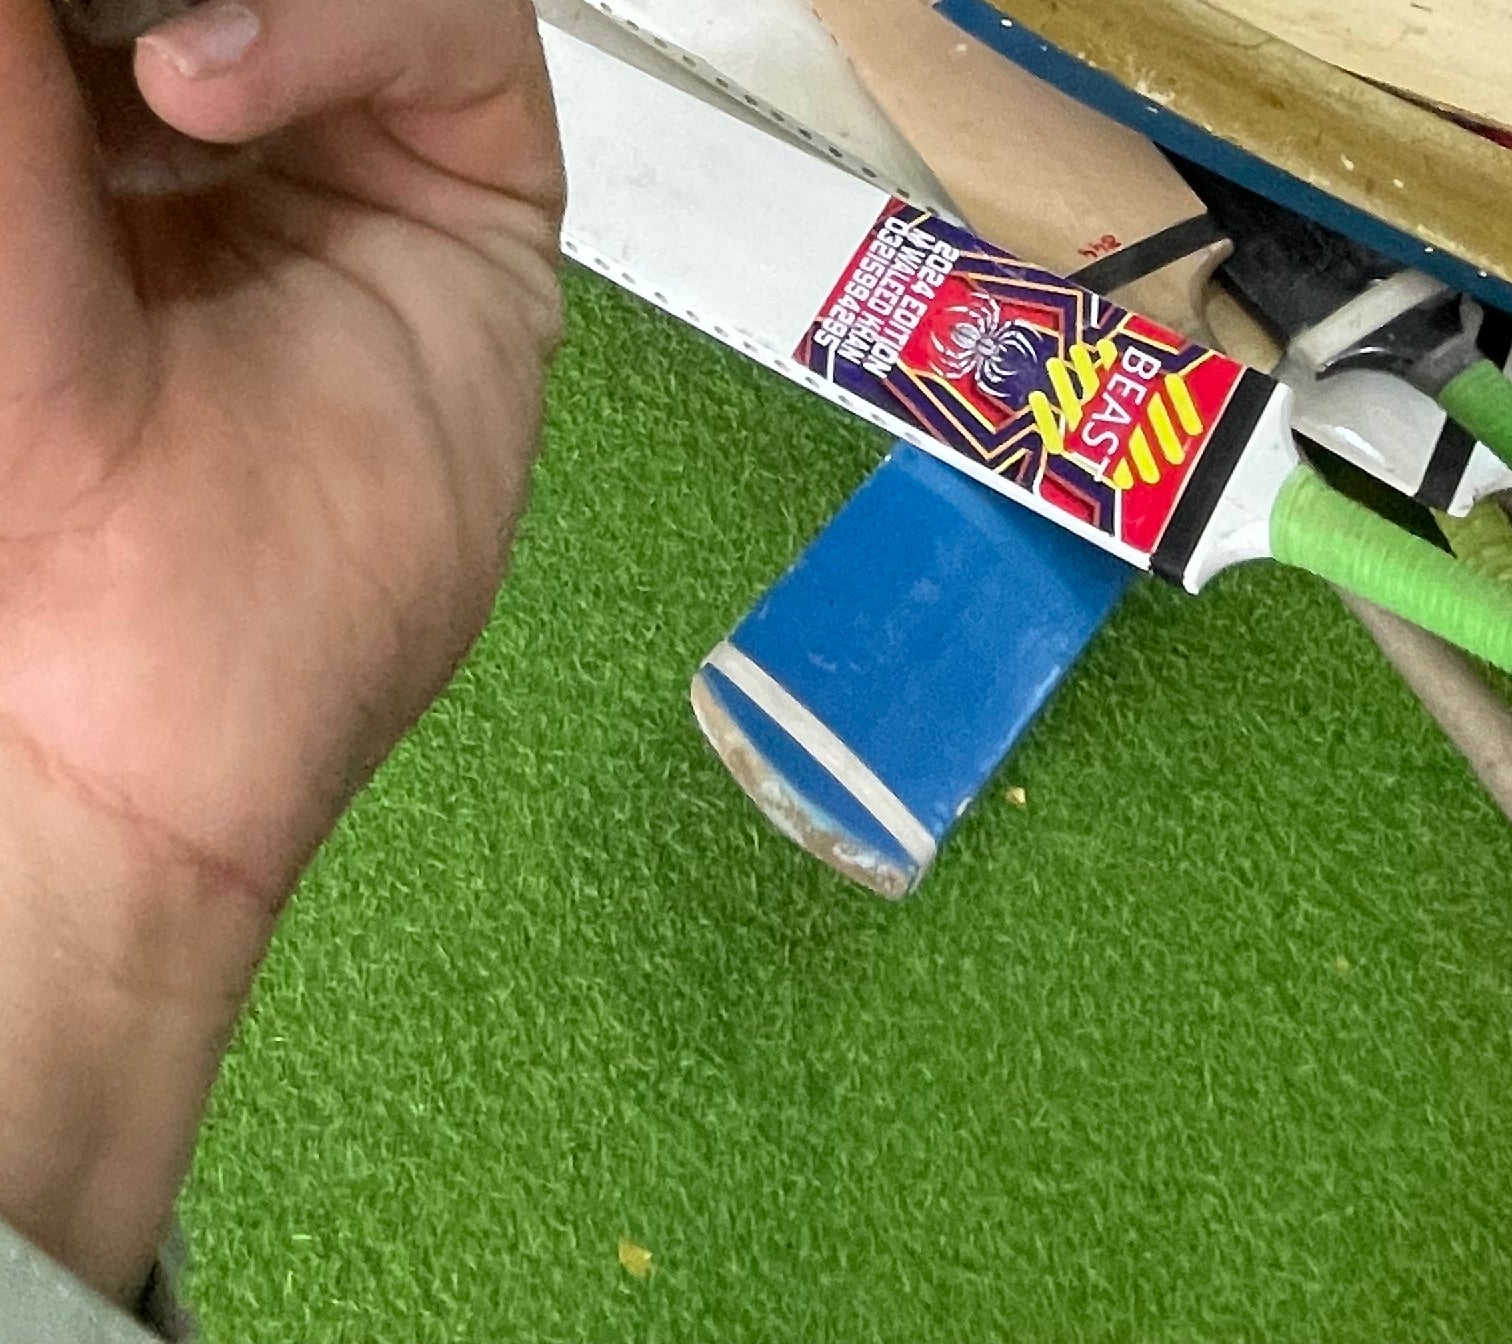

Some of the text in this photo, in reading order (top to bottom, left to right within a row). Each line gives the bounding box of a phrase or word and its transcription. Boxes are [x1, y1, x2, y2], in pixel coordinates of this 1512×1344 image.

[813, 216, 909, 350] 03215994285
[834, 315, 874, 367] KHAN
[863, 233, 959, 379] 2024 EDITION
[866, 243, 921, 326] WALEED
[1082, 345, 1162, 482] BEAST
